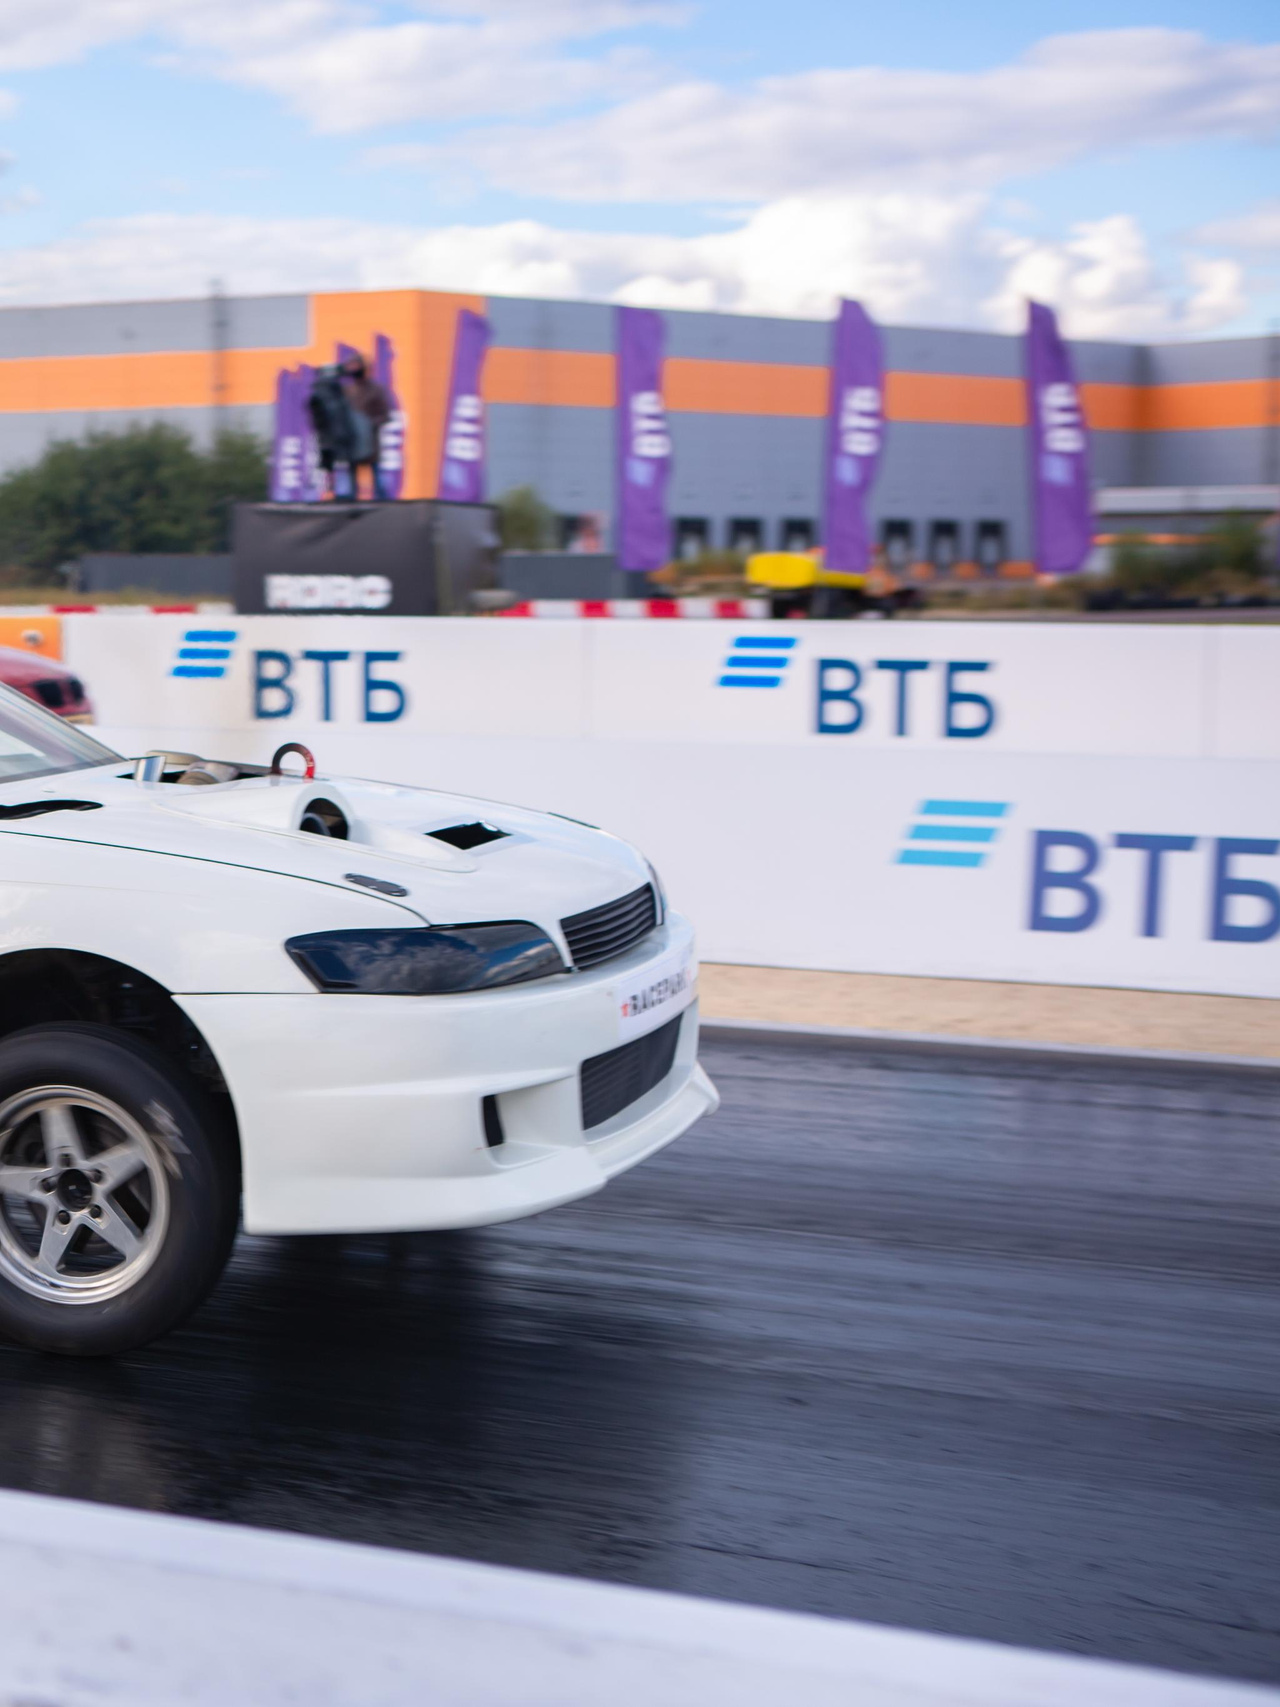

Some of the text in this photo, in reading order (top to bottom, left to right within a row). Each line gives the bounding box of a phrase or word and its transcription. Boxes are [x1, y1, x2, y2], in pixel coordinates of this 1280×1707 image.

[252, 650, 408, 723] ВТБ
[814, 658, 997, 739] ВТБ
[1025, 829, 1280, 943] ВТБ
